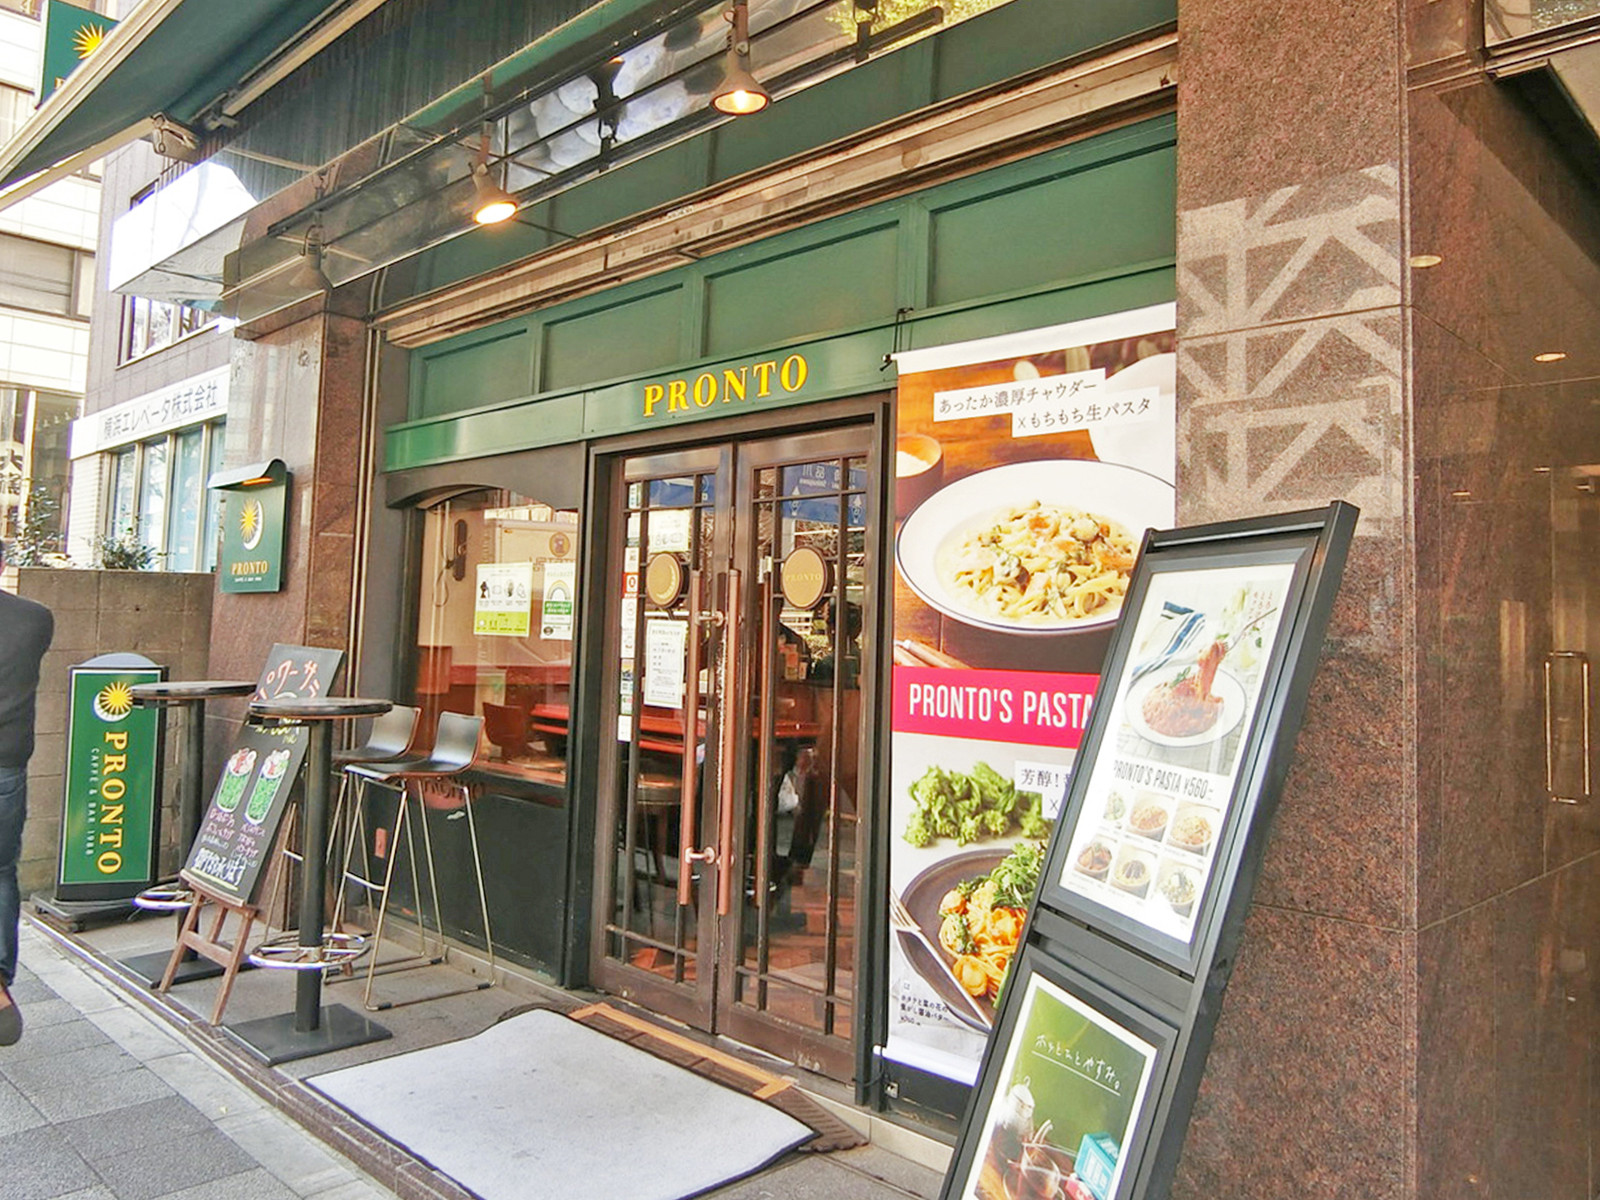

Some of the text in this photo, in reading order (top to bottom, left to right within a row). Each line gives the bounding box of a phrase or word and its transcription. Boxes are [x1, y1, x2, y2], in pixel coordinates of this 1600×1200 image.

[643, 353, 809, 418] PRONTO
[938, 379, 1098, 413] あったか濃厚チャウダー
[231, 560, 268, 576] PRONTO
[909, 683, 1013, 724] PRONTO'S
[1112, 759, 1154, 786] PRONTO'S
[1153, 769, 1183, 793] PASTA
[97, 731, 128, 875] PRONTO
